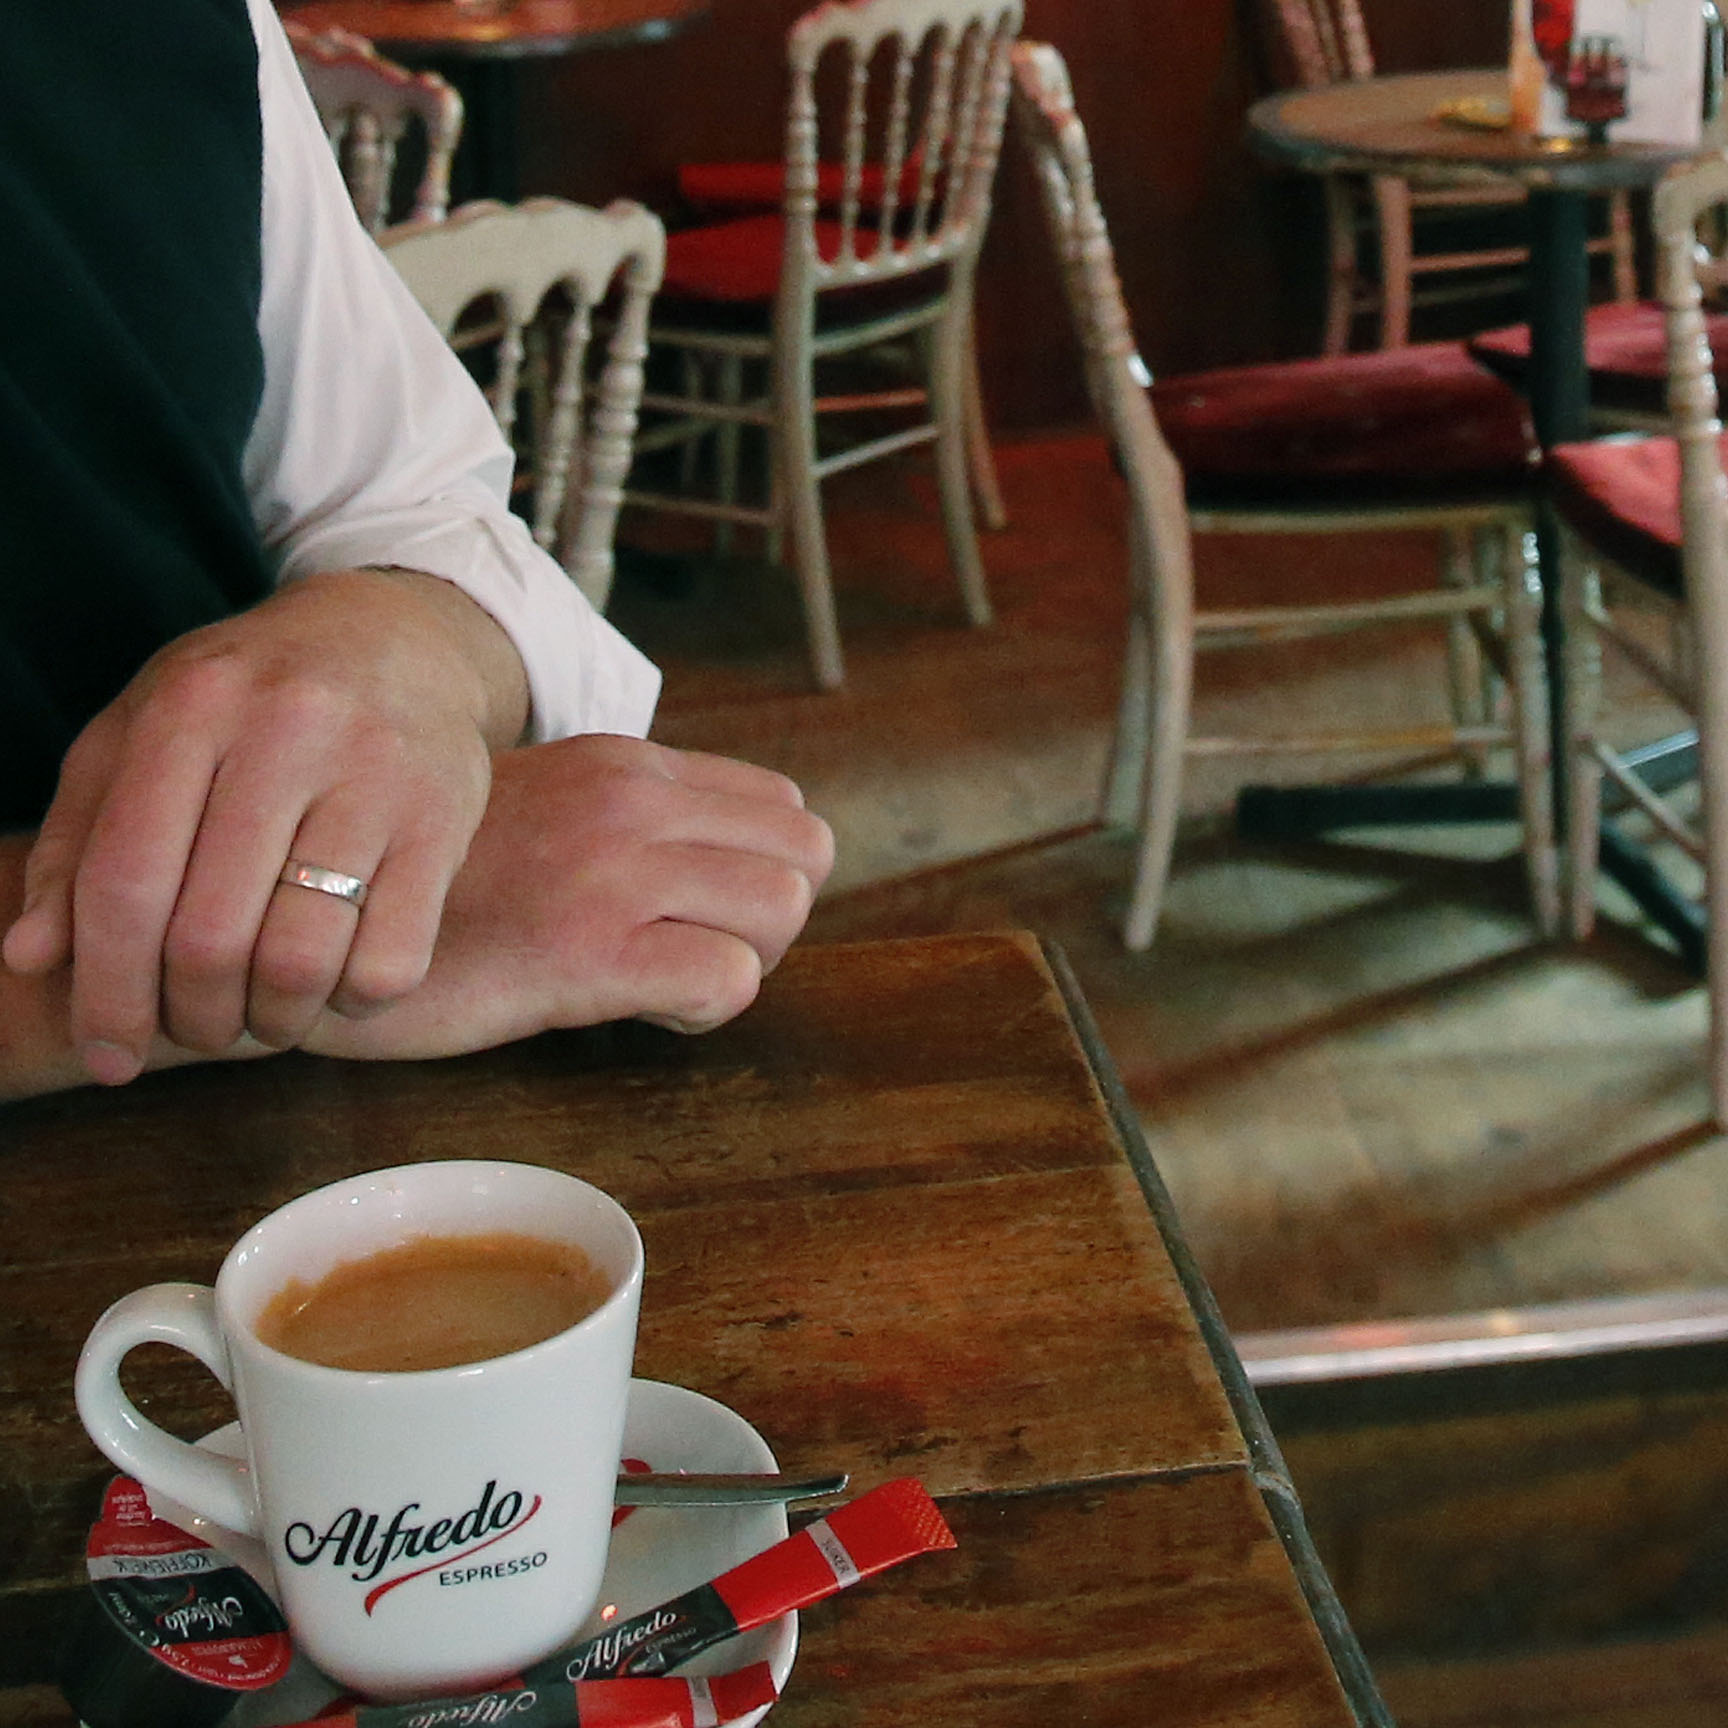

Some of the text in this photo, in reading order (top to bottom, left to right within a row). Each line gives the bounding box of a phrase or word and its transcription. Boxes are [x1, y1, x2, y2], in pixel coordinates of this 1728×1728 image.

[285, 1480, 522, 1582] Alfredo
[439, 1552, 548, 1586] ESPRESSO
[165, 1596, 245, 1639] Alfredo
[566, 1611, 677, 1682] Alfredo
